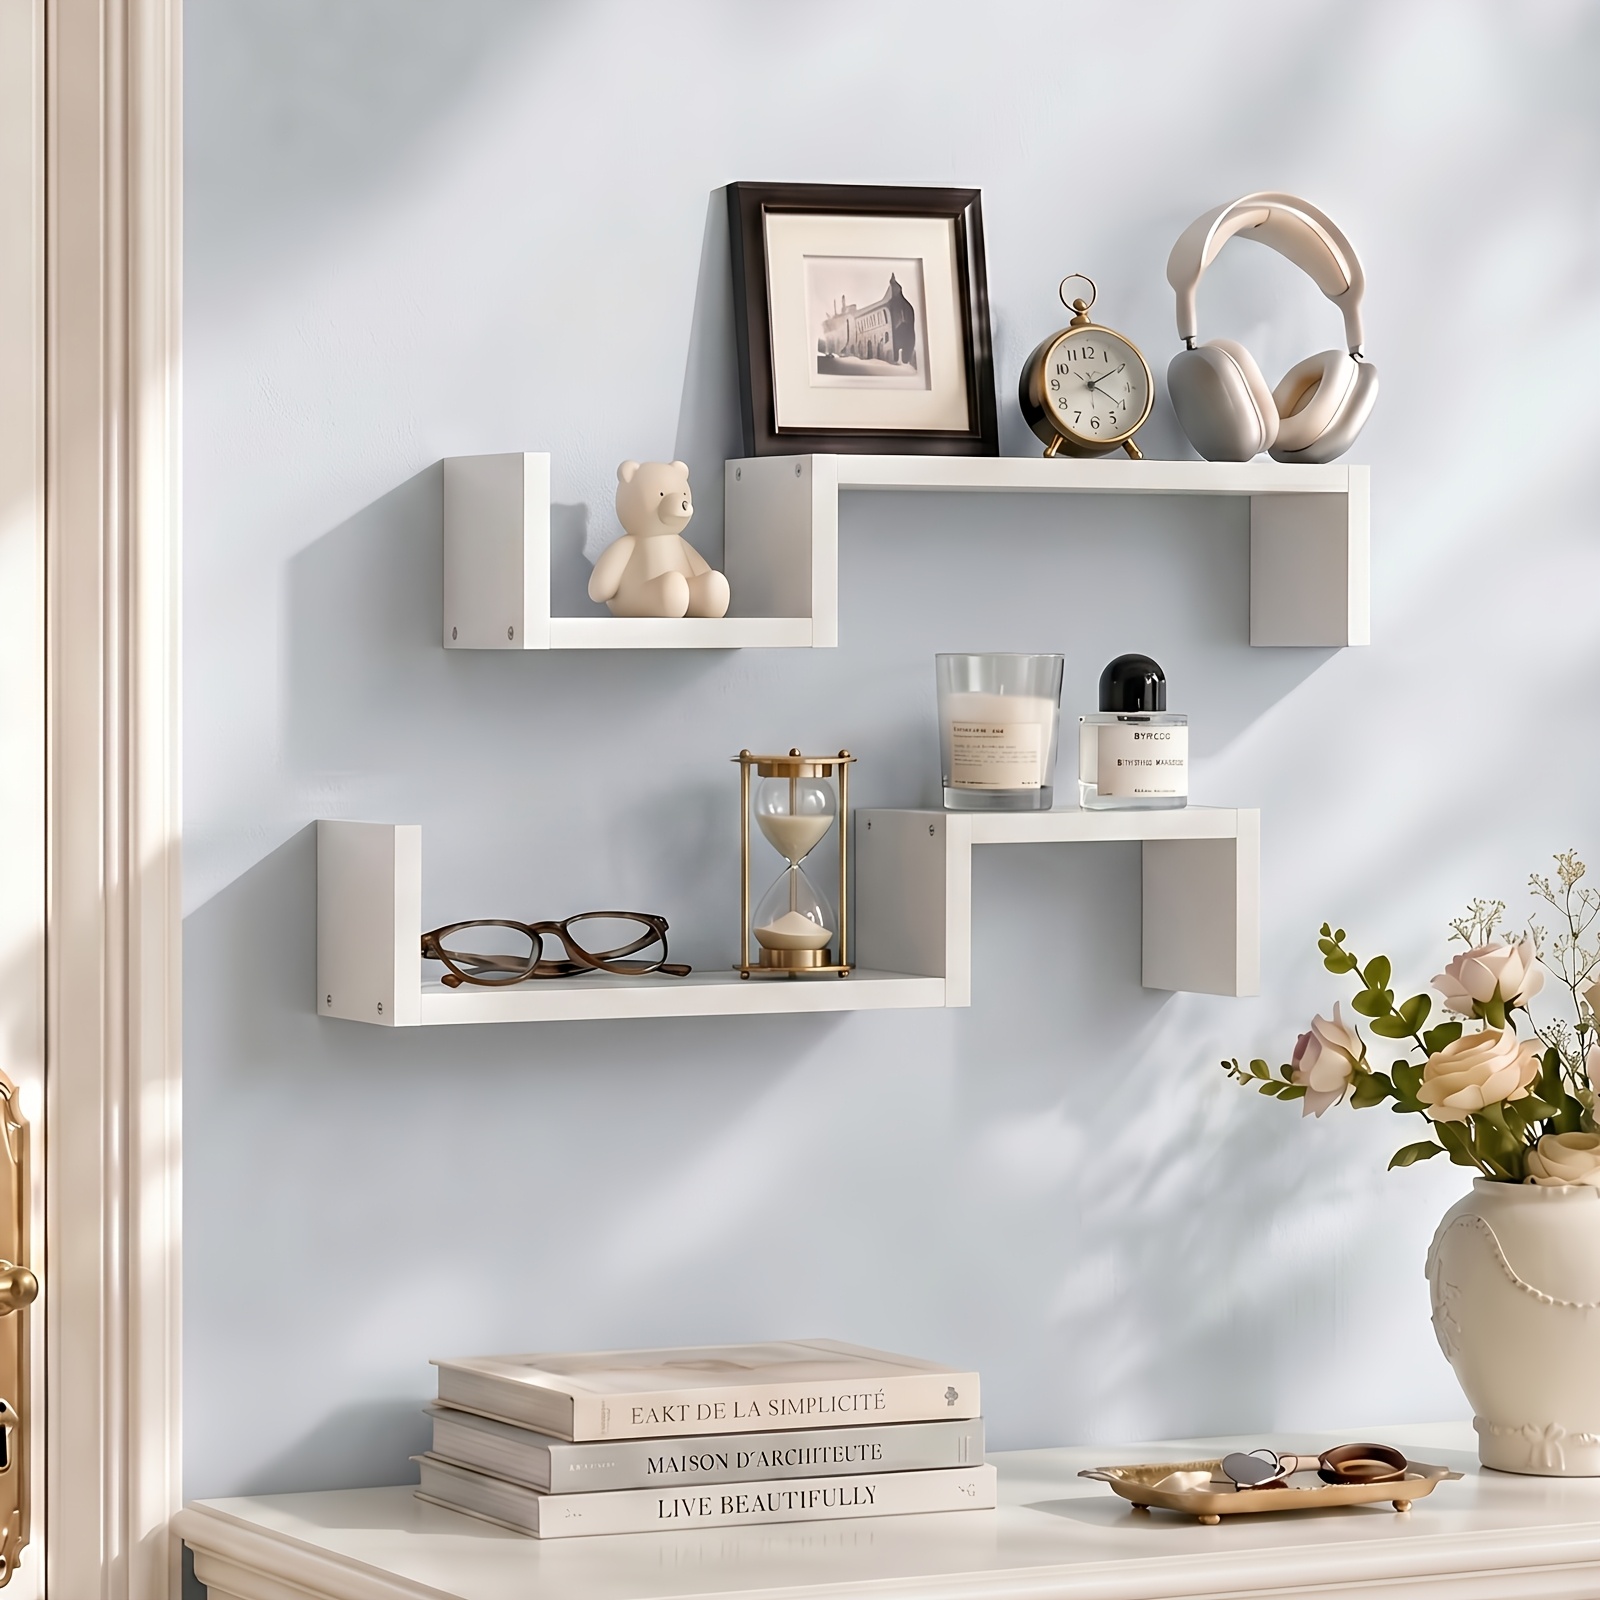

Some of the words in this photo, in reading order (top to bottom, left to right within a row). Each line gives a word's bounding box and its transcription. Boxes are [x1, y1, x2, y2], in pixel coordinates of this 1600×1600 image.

[1067, 349, 1077, 361] 11
[1082, 346, 1095, 359] 12
[1103, 351, 1108, 363] 1
[1056, 363, 1069, 375] 10
[1051, 379, 1060, 391] 9
[1058, 397, 1068, 410] 8
[1074, 410, 1082, 423] 7
[1090, 416, 1100, 429] 6
[1109, 411, 1117, 424] 5
[631, 1406, 690, 1425] EAKT
[696, 1402, 727, 1421] DE
[733, 1401, 761, 1419] LA
[768, 1388, 886, 1417] SIMPLICITÉ
[647, 1452, 729, 1475] MAISON
[658, 1496, 712, 1519] LIVE
[720, 1485, 877, 1515] BEAUTIFULLY
